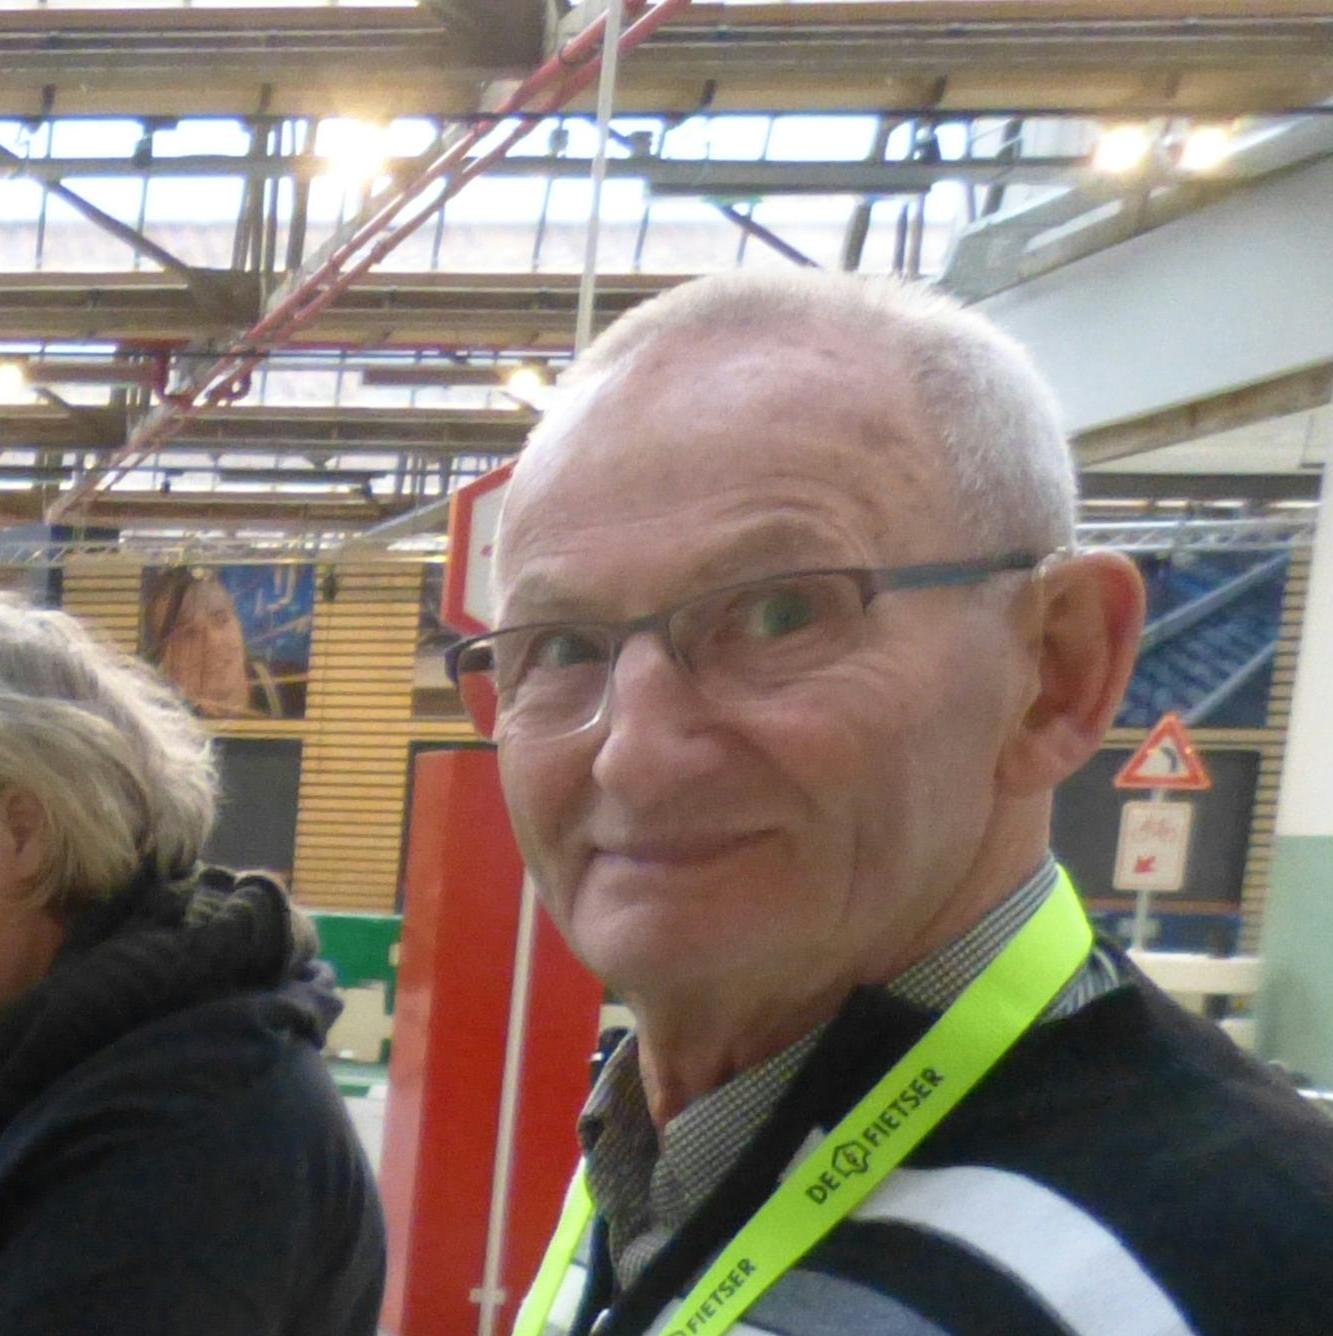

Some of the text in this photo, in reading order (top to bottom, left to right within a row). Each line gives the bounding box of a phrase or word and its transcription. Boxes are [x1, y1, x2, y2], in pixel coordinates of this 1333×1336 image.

[805, 1067, 945, 1205] DE FIETSER
[686, 1257, 757, 1335] FIETSER
